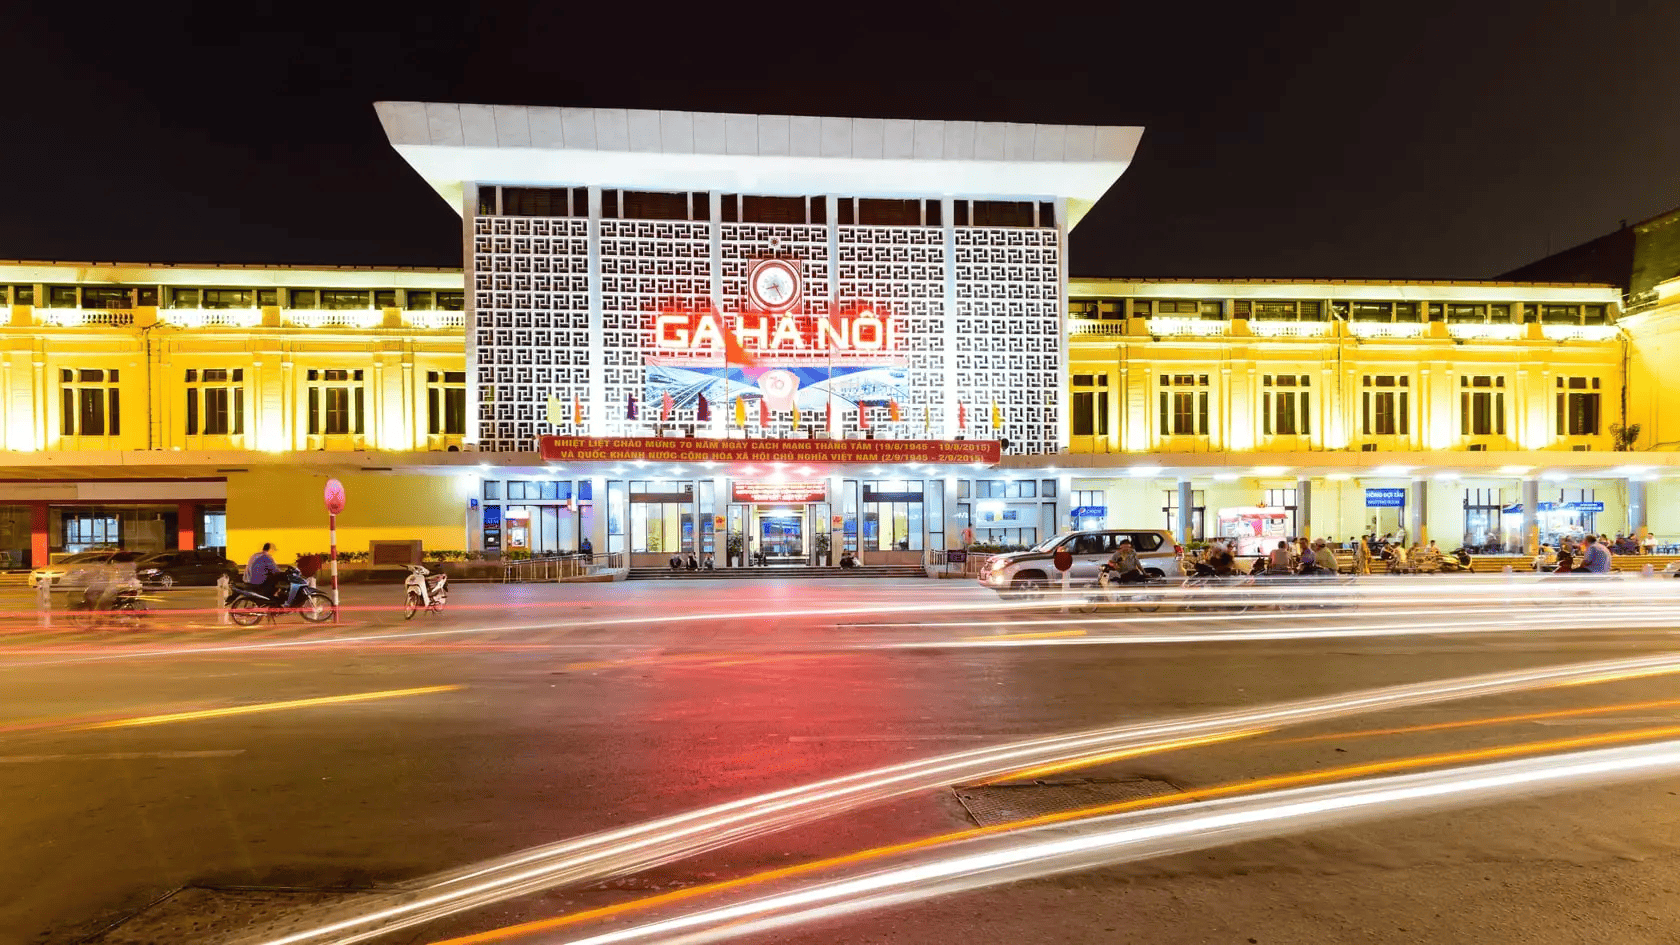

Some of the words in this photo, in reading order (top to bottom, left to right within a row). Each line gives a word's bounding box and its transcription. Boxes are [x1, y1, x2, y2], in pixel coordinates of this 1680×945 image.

[656, 315, 726, 349] GA
[554, 439, 585, 448] NHIỆT
[588, 439, 610, 448] LIỆT
[613, 439, 642, 448] CHÀO
[680, 441, 693, 449] 70
[696, 440, 719, 449] NĂM
[752, 441, 779, 450] CÁCH
[815, 441, 847, 450] THÁNG
[850, 442, 872, 450] TÁM
[875, 443, 928, 451] (19/8/1945
[939, 443, 990, 452] 19/8/2015)
[561, 450, 574, 458] VÀ
[577, 449, 606, 459] QUỐC
[648, 450, 677, 459] NƯỚC
[680, 451, 709, 460] CỘNG
[736, 451, 749, 460] XÃ
[752, 452, 770, 461] HỘI
[773, 451, 794, 460] CHỦ
[797, 452, 828, 461] NGHĨA
[830, 452, 852, 461] VIỆT
[882, 453, 928, 461] (2/9/1945
[939, 454, 984, 462] 2/9/2015)
